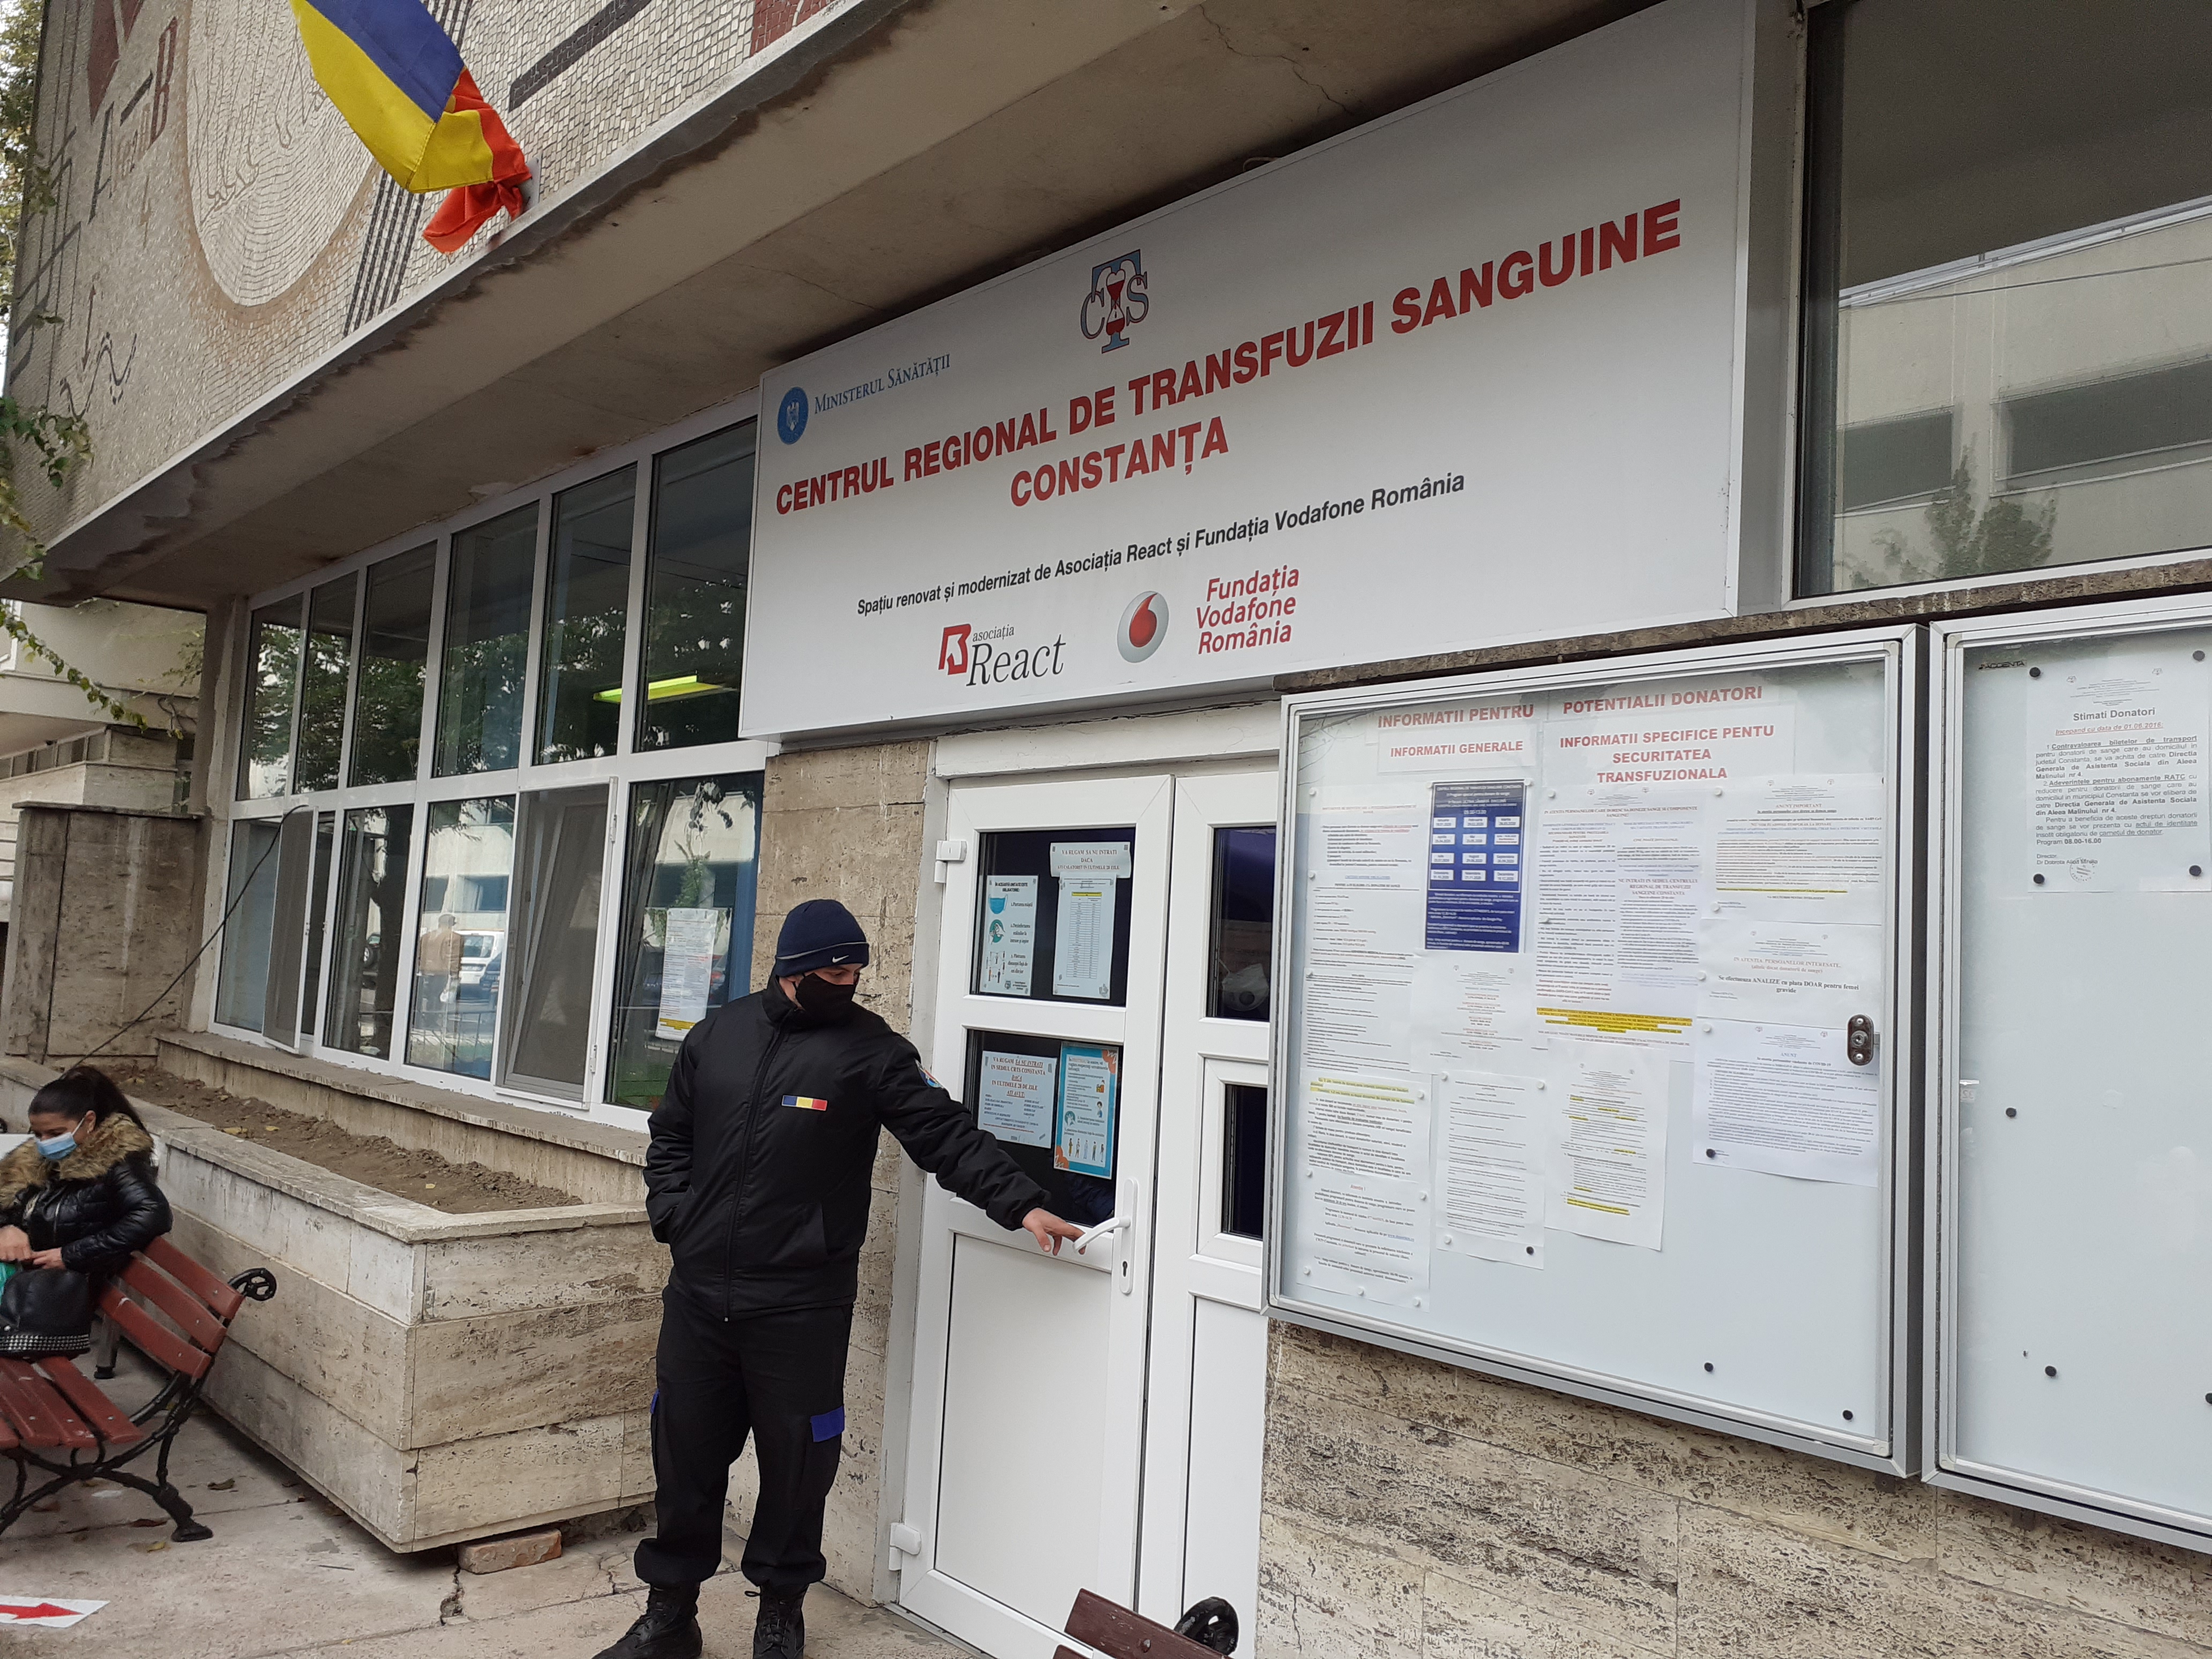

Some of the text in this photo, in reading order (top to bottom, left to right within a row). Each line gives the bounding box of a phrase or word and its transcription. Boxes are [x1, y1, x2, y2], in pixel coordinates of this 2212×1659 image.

[776, 198, 1680, 514] CENTRUL REGIONAL DE TRANSFUZII SANGUINE
[815, 379, 884, 414] MINISTERUL
[1010, 415, 1228, 506] CONSTANȚA
[858, 473, 1464, 616] Spațiu renovat și modernizat de Asociația React și Fundația Vodafone România
[1207, 565, 1299, 602] Fundația
[1197, 597, 1296, 629] Vodafone
[973, 624, 1014, 642] asociația
[1199, 622, 1291, 654] România
[966, 633, 1066, 686] React
[1378, 686, 1762, 729] INFORMATII PENTRU POTENTIALII DONATORI
[2073, 707, 2155, 721] Stimati Donatori
[1391, 741, 1522, 757] INFORMATII GENERALE
[1560, 726, 1774, 748] INFORMATII SPECIFICE PENTU
[1613, 749, 1711, 763] SECURITATEA
[1597, 768, 1727, 784] TRANSFUZIONALA
